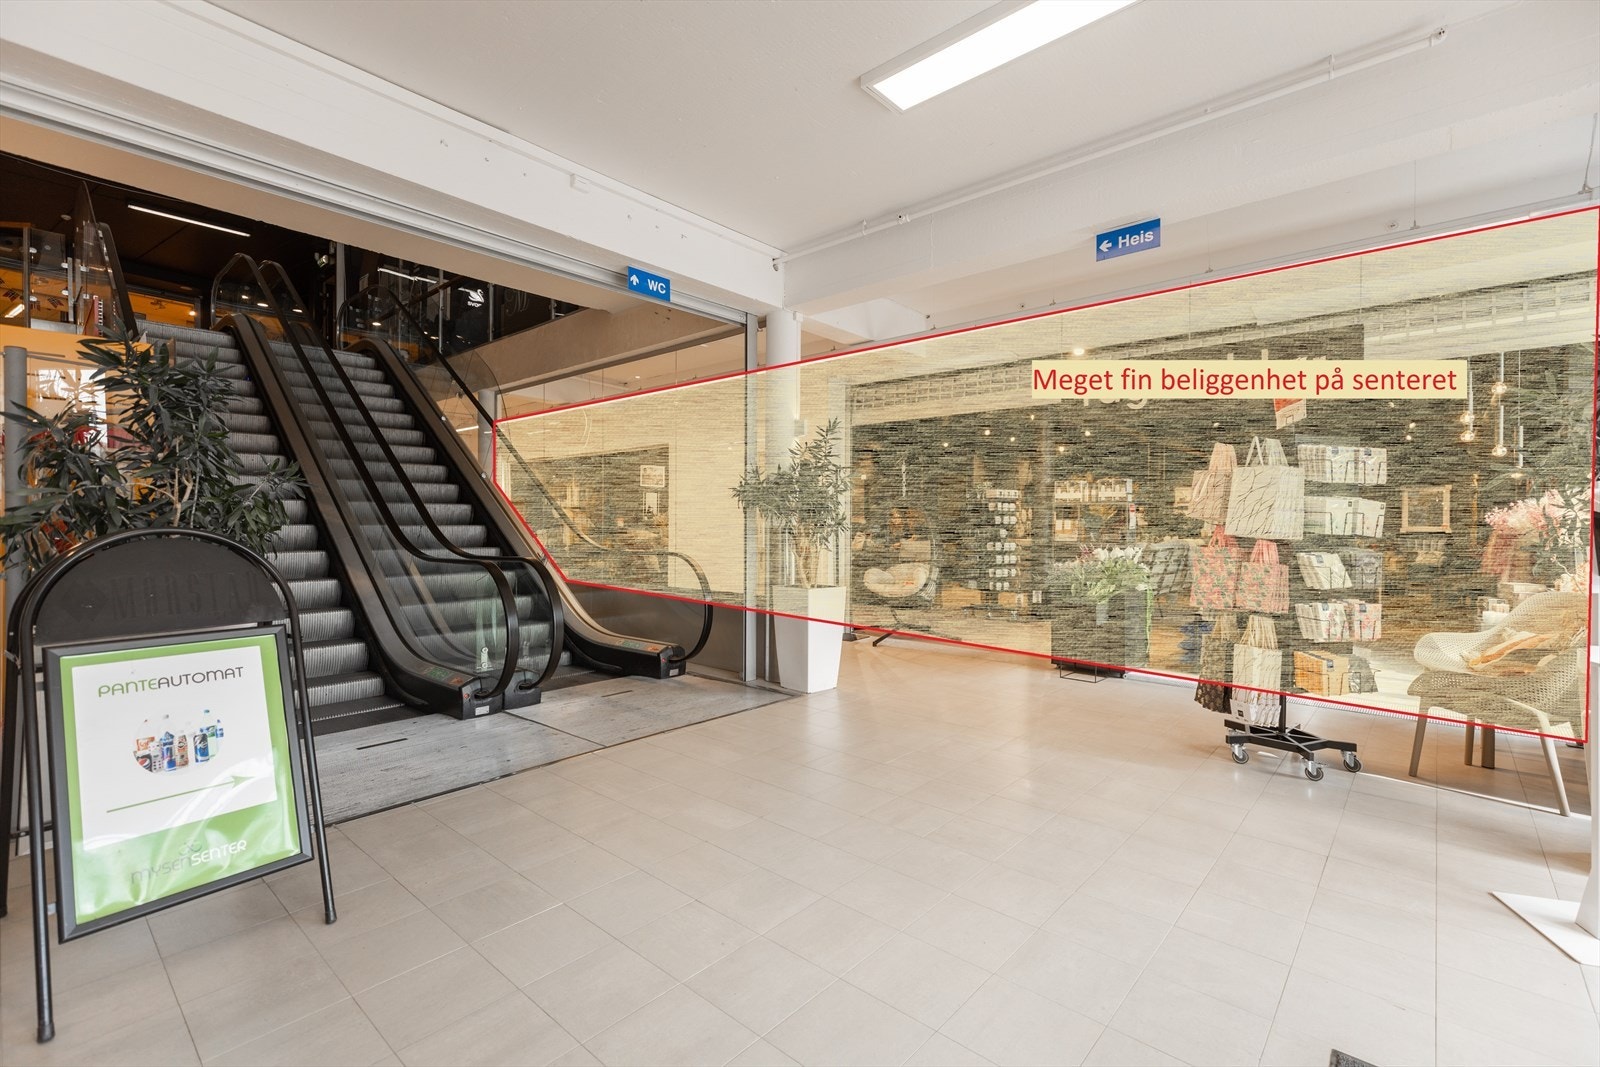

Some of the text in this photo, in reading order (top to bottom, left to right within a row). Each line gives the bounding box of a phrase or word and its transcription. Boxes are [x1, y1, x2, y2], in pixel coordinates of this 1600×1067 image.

[1118, 230, 1154, 249] Heis
[647, 278, 666, 294] WC
[98, 666, 244, 698] PANTEAUTOMAT
